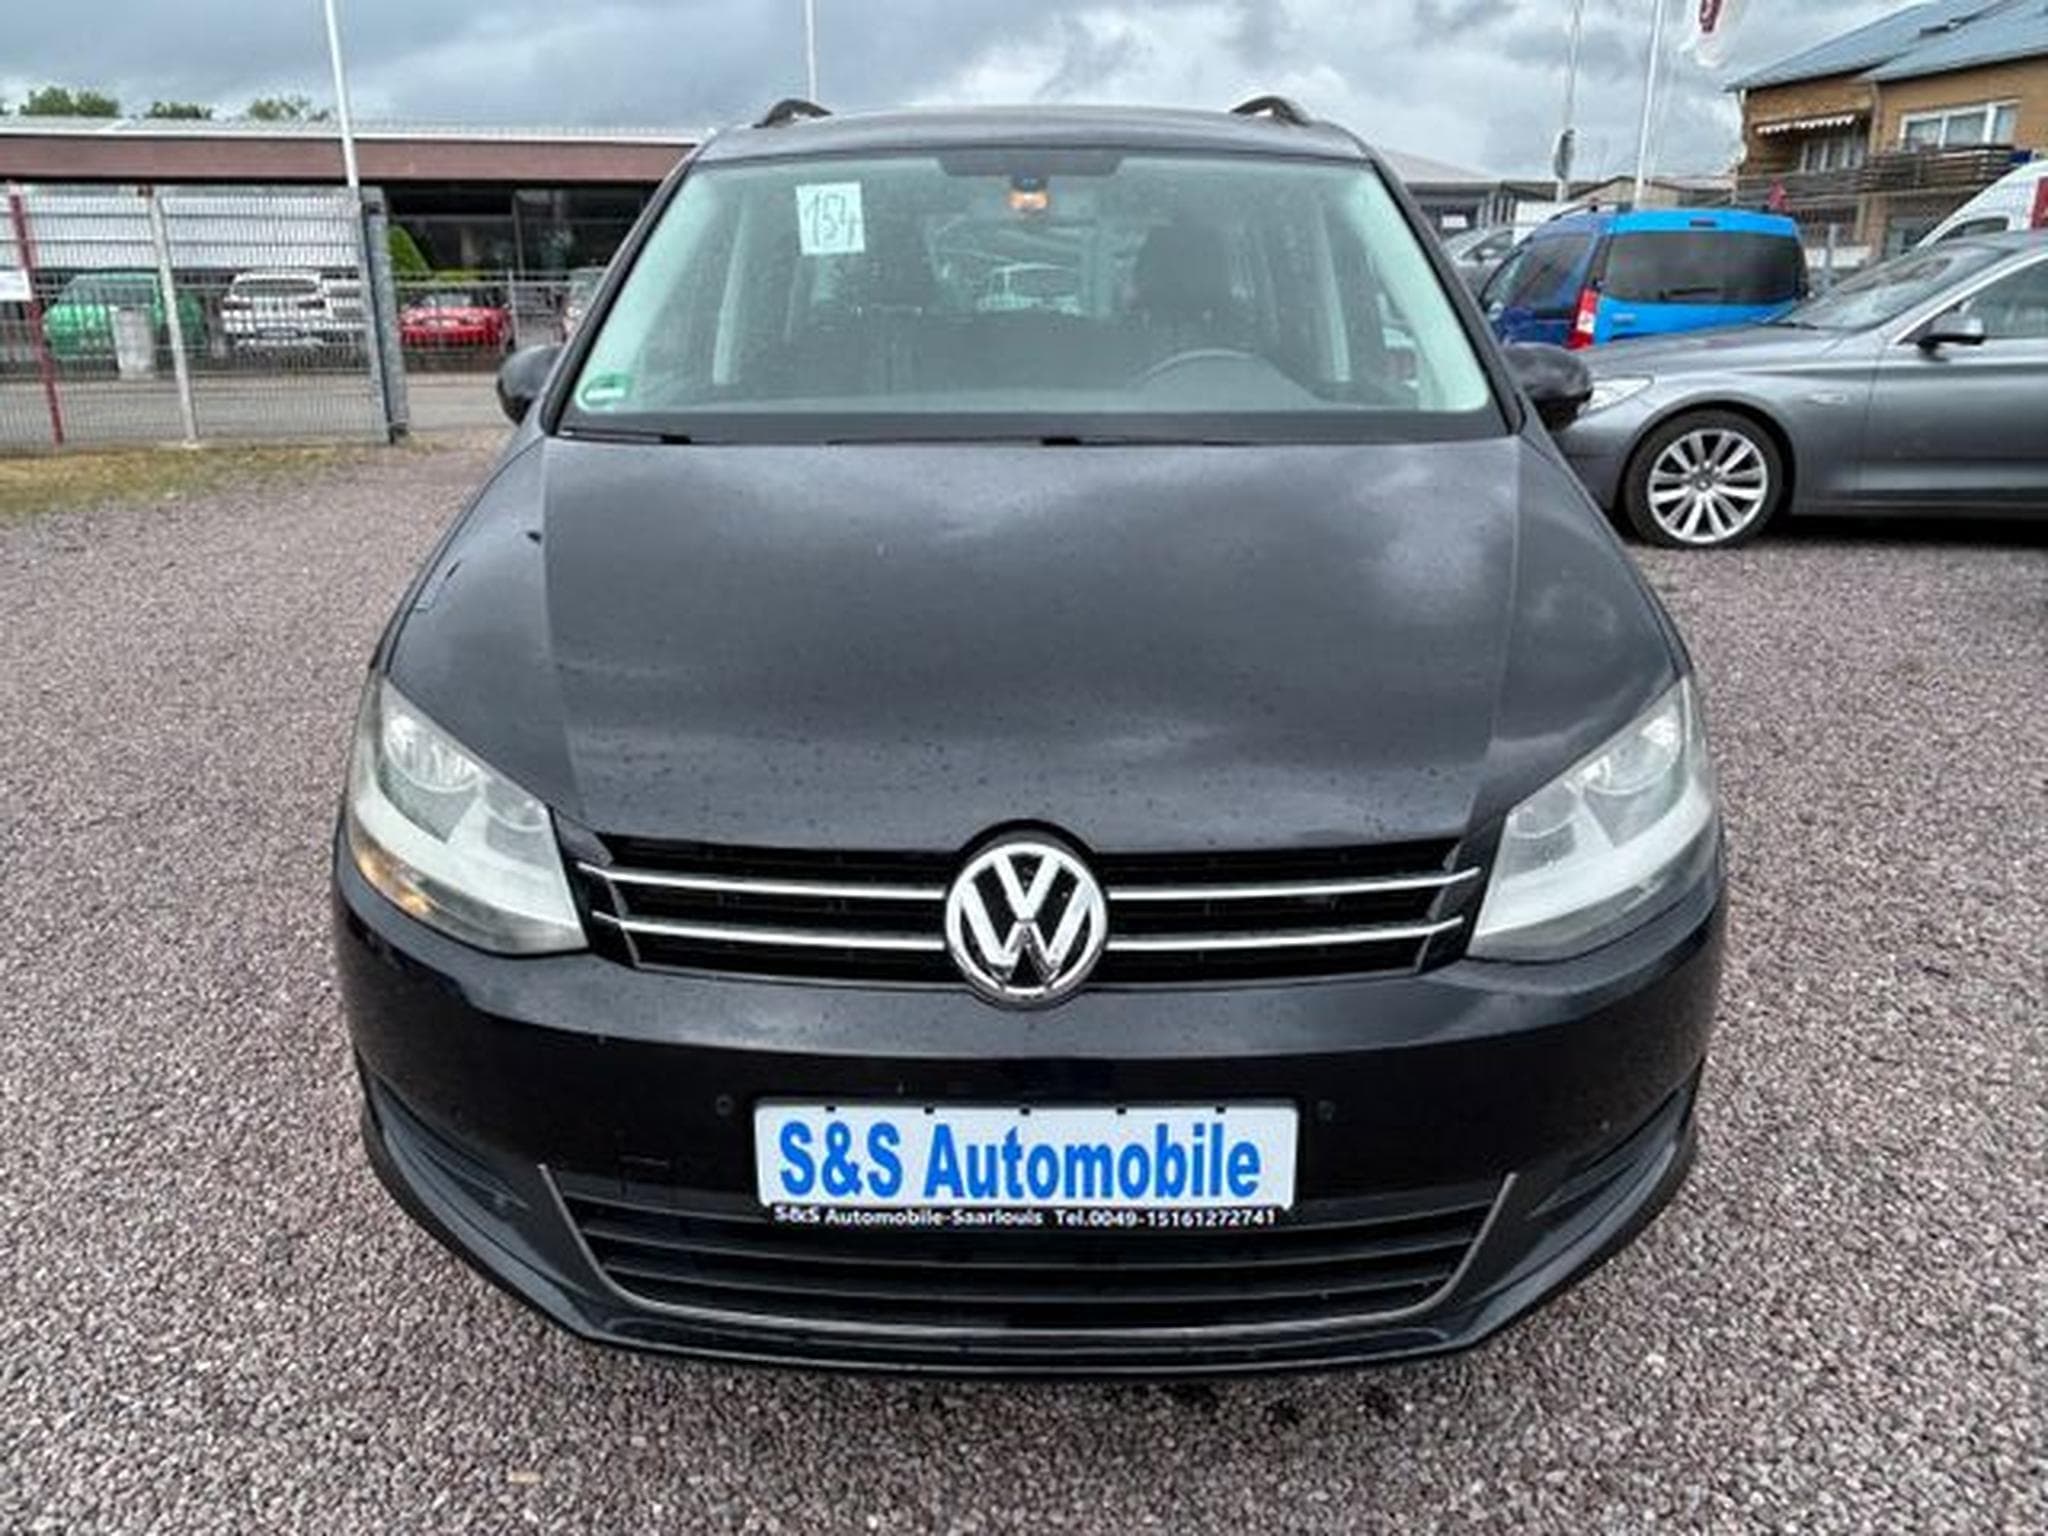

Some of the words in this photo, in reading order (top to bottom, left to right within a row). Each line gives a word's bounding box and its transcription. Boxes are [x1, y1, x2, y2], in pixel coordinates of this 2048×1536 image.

[779, 1121, 904, 1198] S&S
[923, 1122, 1262, 1199] Automobile
[773, 1205, 820, 1223] S&S
